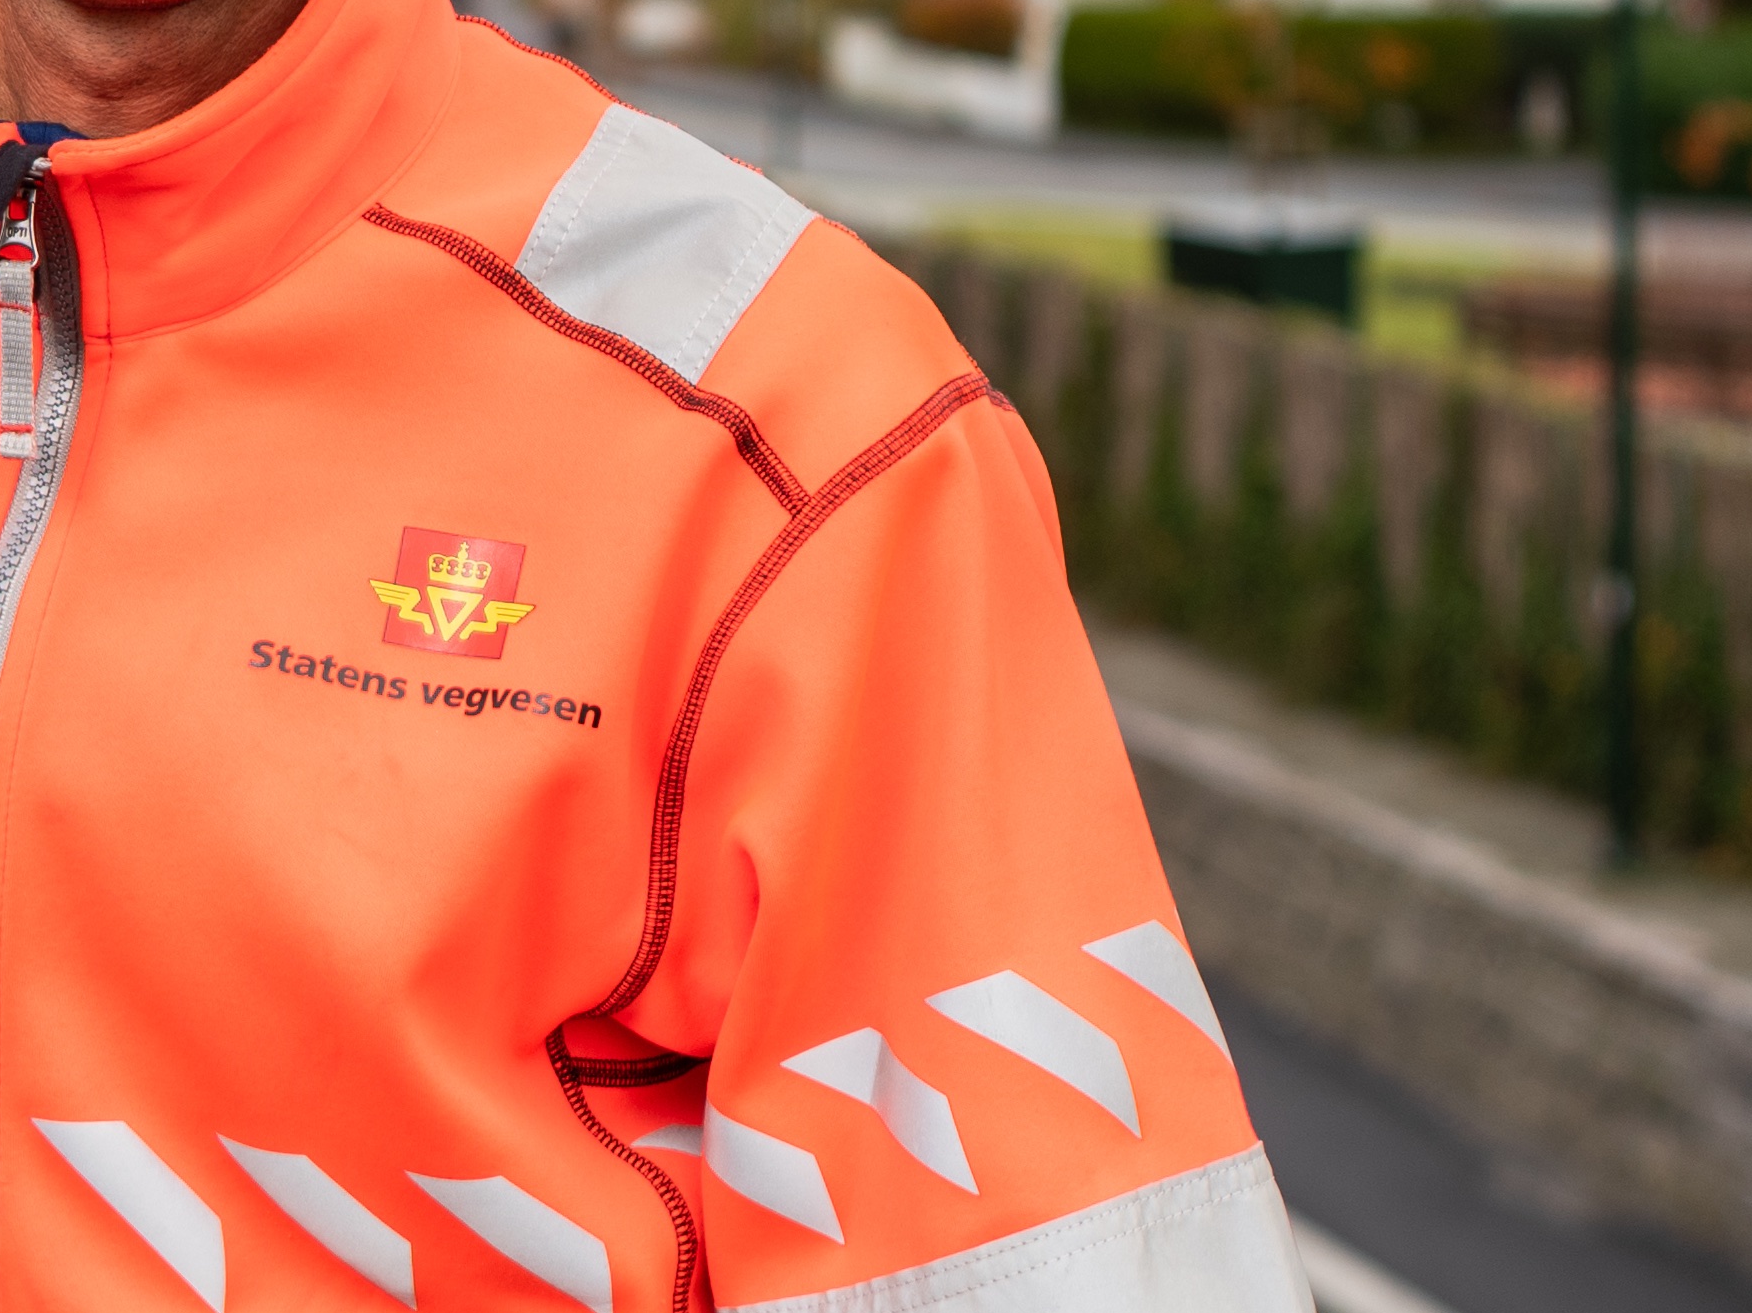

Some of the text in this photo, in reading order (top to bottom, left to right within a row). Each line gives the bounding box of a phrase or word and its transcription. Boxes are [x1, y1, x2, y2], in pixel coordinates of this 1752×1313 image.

[6, 227, 29, 238] OPTI
[248, 639, 603, 729] Statens vegvesen
